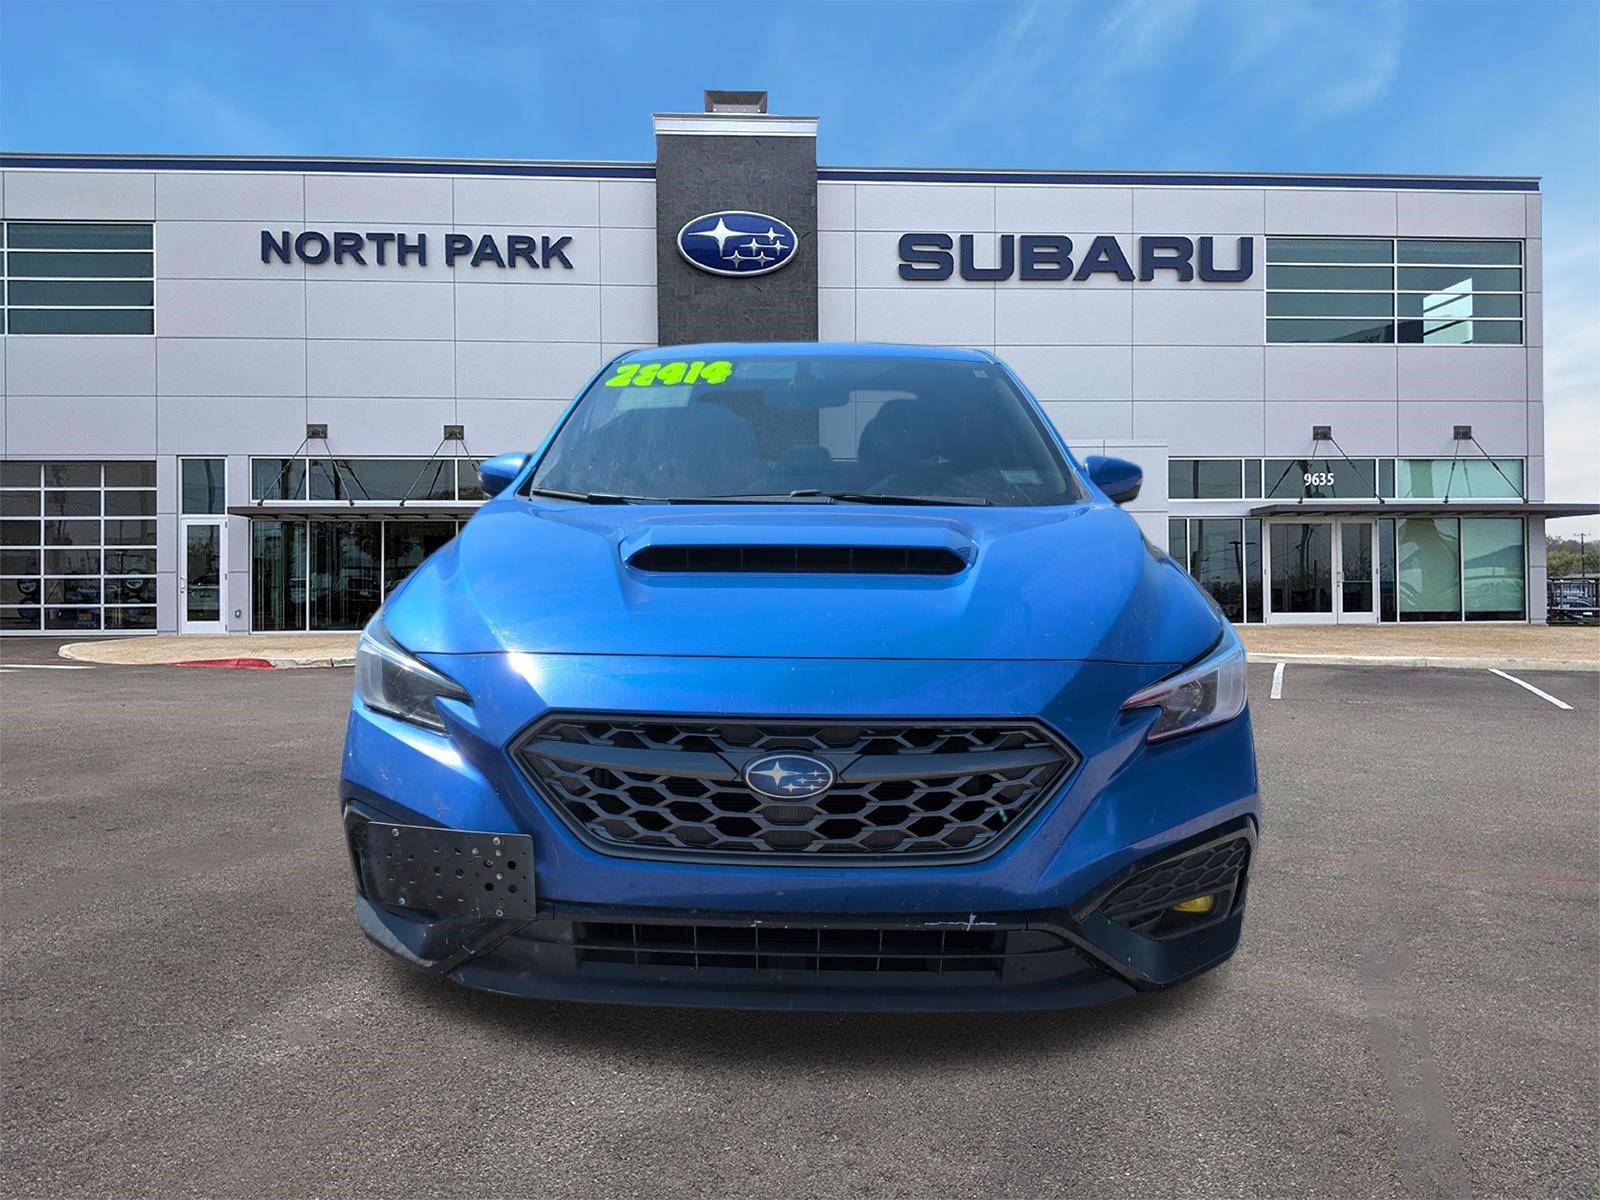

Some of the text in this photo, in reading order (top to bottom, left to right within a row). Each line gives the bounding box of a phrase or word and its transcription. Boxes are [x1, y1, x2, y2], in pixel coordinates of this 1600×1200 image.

[260, 230, 574, 269] NORTH PARK
[898, 232, 1254, 282] SUBARU
[1303, 472, 1335, 486] 9635
